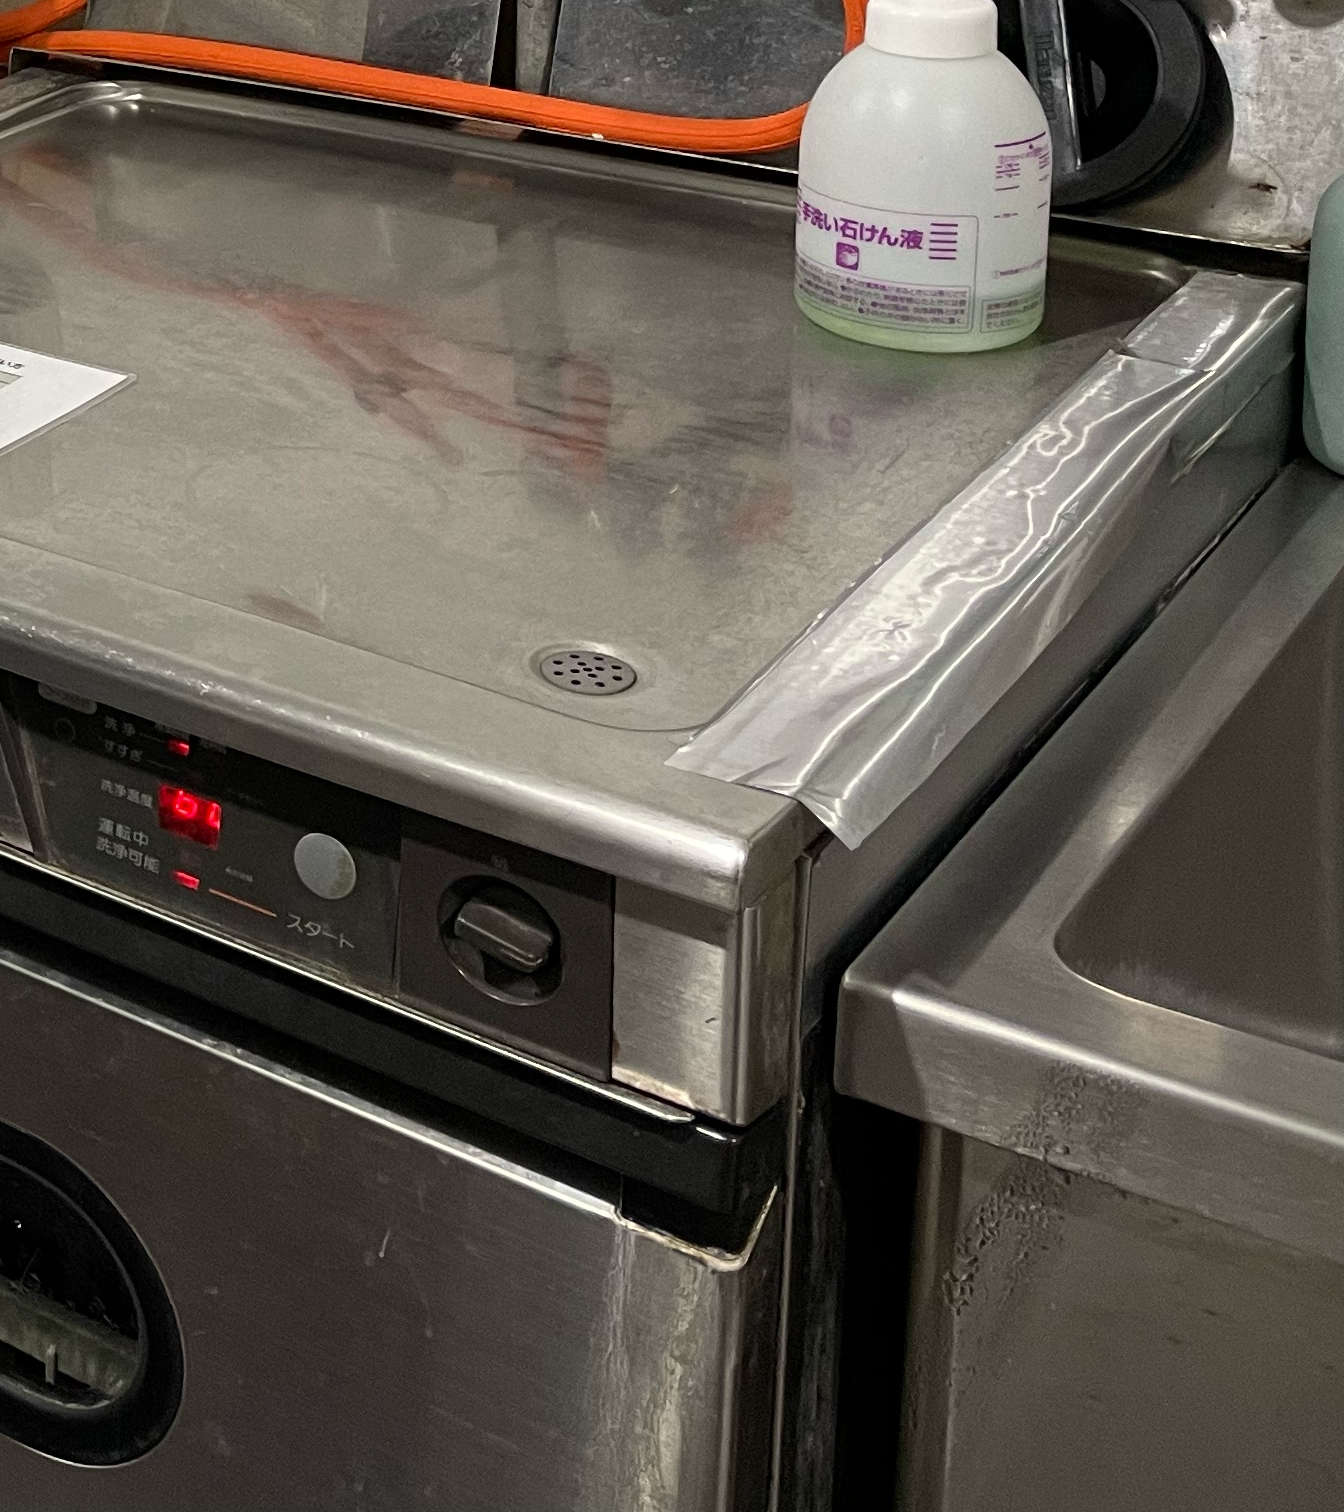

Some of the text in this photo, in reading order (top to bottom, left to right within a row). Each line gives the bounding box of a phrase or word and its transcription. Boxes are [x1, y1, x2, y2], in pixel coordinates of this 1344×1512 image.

[800, 201, 925, 250] 手洗い石けん液
[100, 778, 154, 809] 洗浄温度
[98, 817, 149, 847] 運転中
[96, 836, 161, 874] 洗浄可能
[286, 912, 356, 949] スタート
